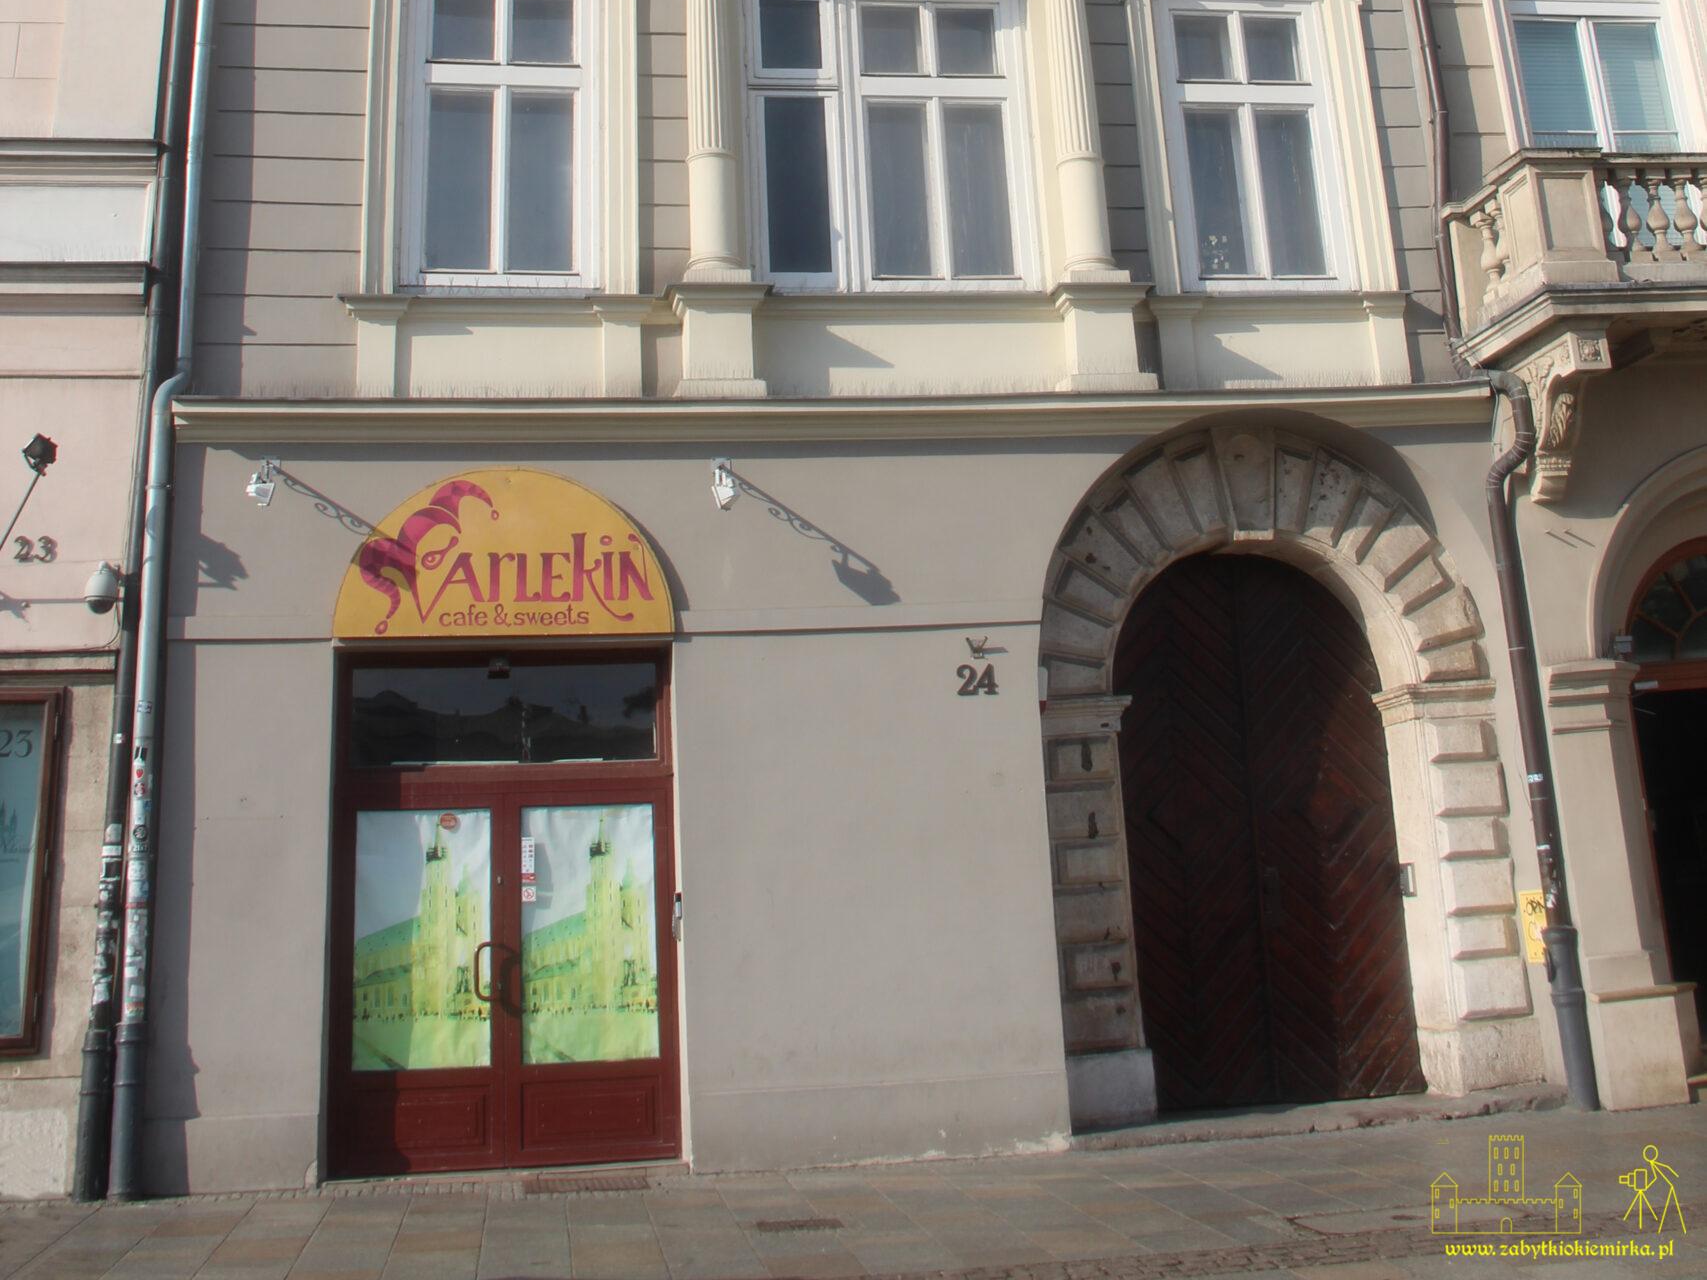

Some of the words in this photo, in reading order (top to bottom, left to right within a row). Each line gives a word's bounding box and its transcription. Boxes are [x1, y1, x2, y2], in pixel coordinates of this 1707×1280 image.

[14, 536, 57, 563] 23
[439, 604, 488, 627] cafe
[956, 663, 999, 696] 24
